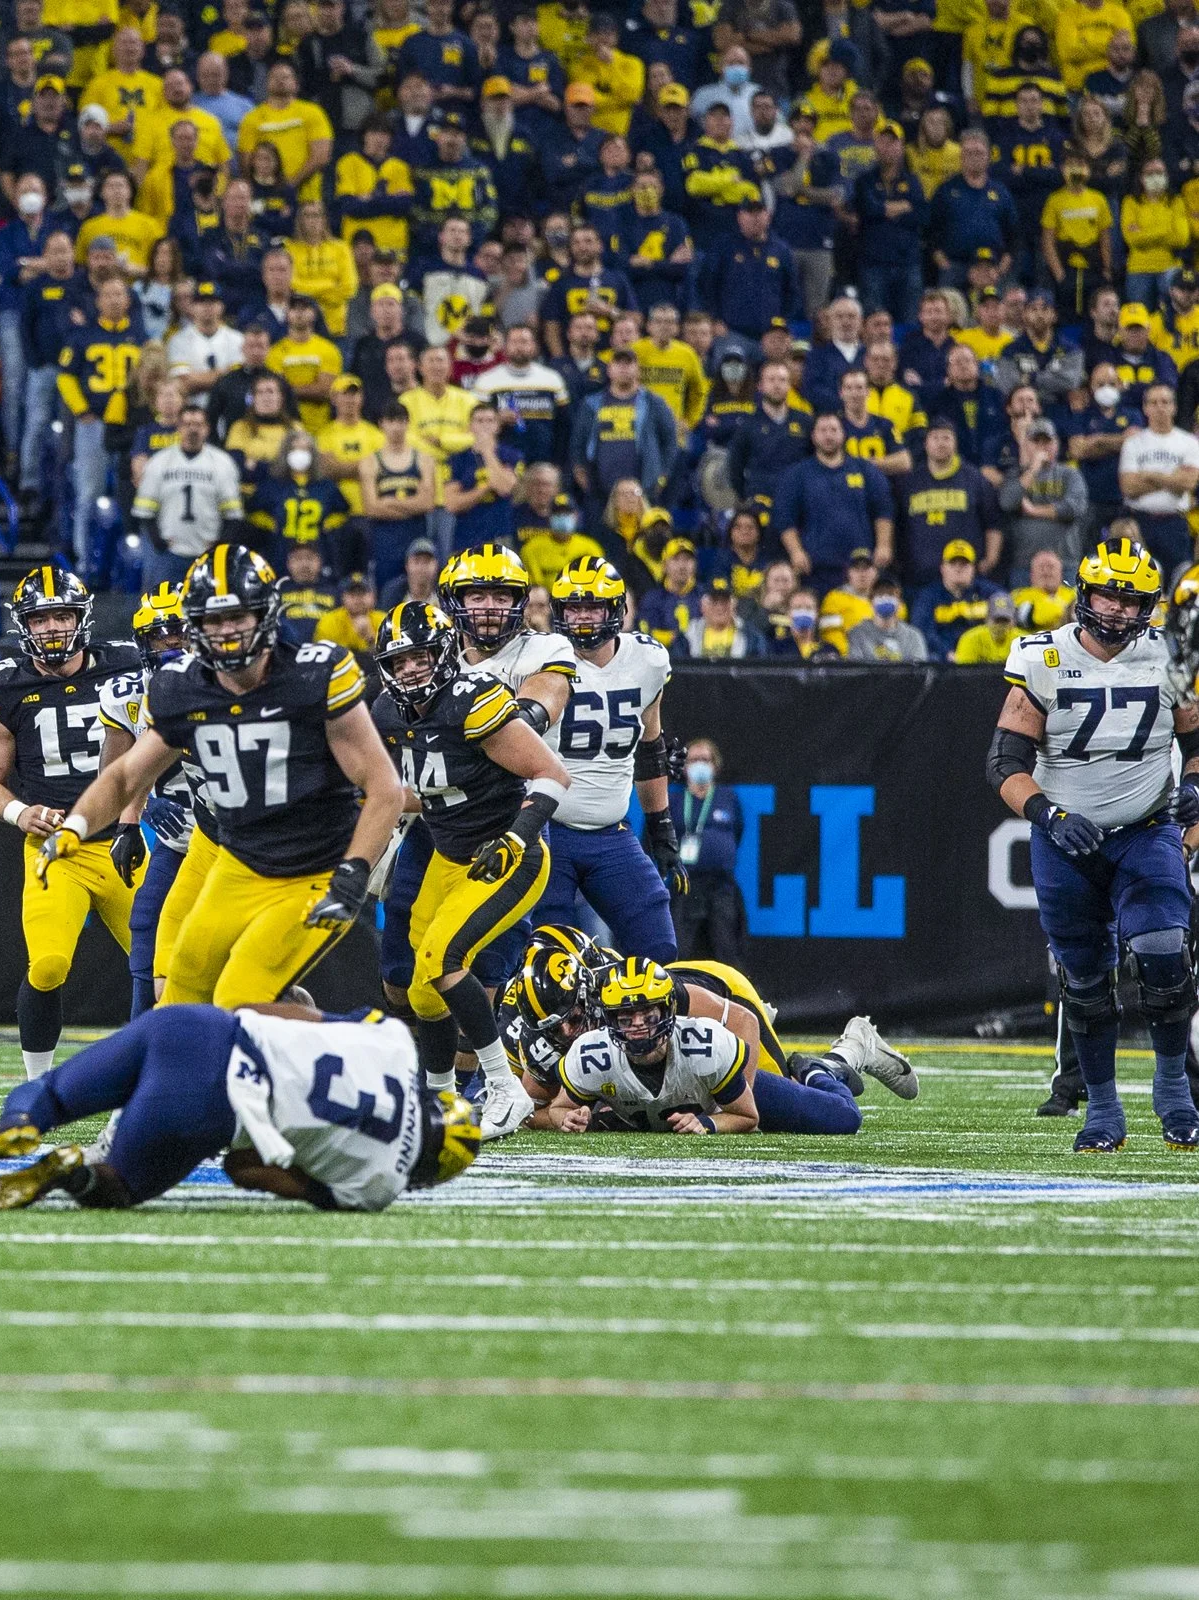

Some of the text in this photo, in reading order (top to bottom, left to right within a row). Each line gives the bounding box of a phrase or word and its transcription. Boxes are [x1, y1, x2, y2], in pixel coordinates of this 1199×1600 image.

[118, 86, 145, 106] M
[431, 177, 475, 210] M
[182, 483, 196, 521] 1
[283, 498, 323, 541] 12
[34, 702, 105, 777] 13
[558, 687, 645, 760] 65
[1056, 685, 1160, 762] 77
[195, 721, 291, 809] 97
[580, 1041, 612, 1075] 12
[678, 1027, 713, 1059] 12
[236, 1061, 262, 1085] M
[307, 1053, 406, 1146] 3
